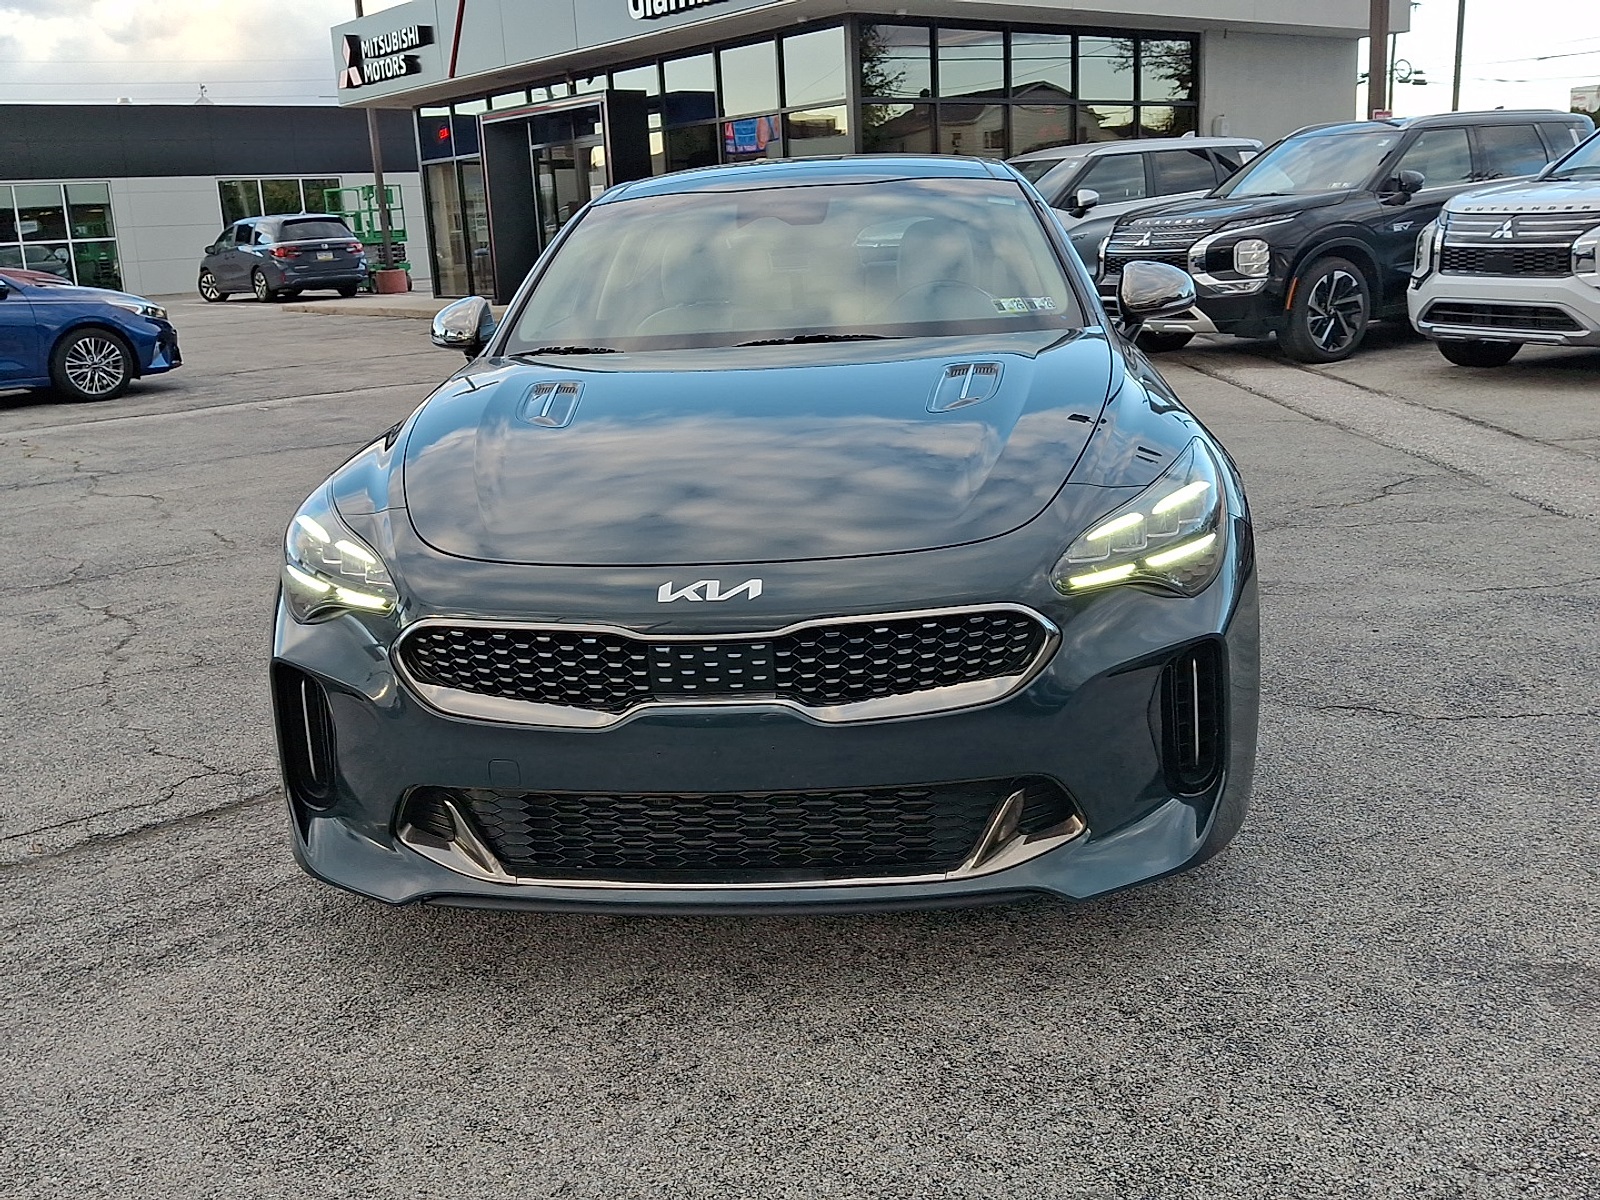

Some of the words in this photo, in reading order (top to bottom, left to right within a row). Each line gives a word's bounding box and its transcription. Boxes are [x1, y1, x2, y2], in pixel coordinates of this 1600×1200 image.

[360, 24, 420, 59] MITSUBISHI
[363, 54, 407, 83] MOTORS
[657, 578, 763, 603] KIA
